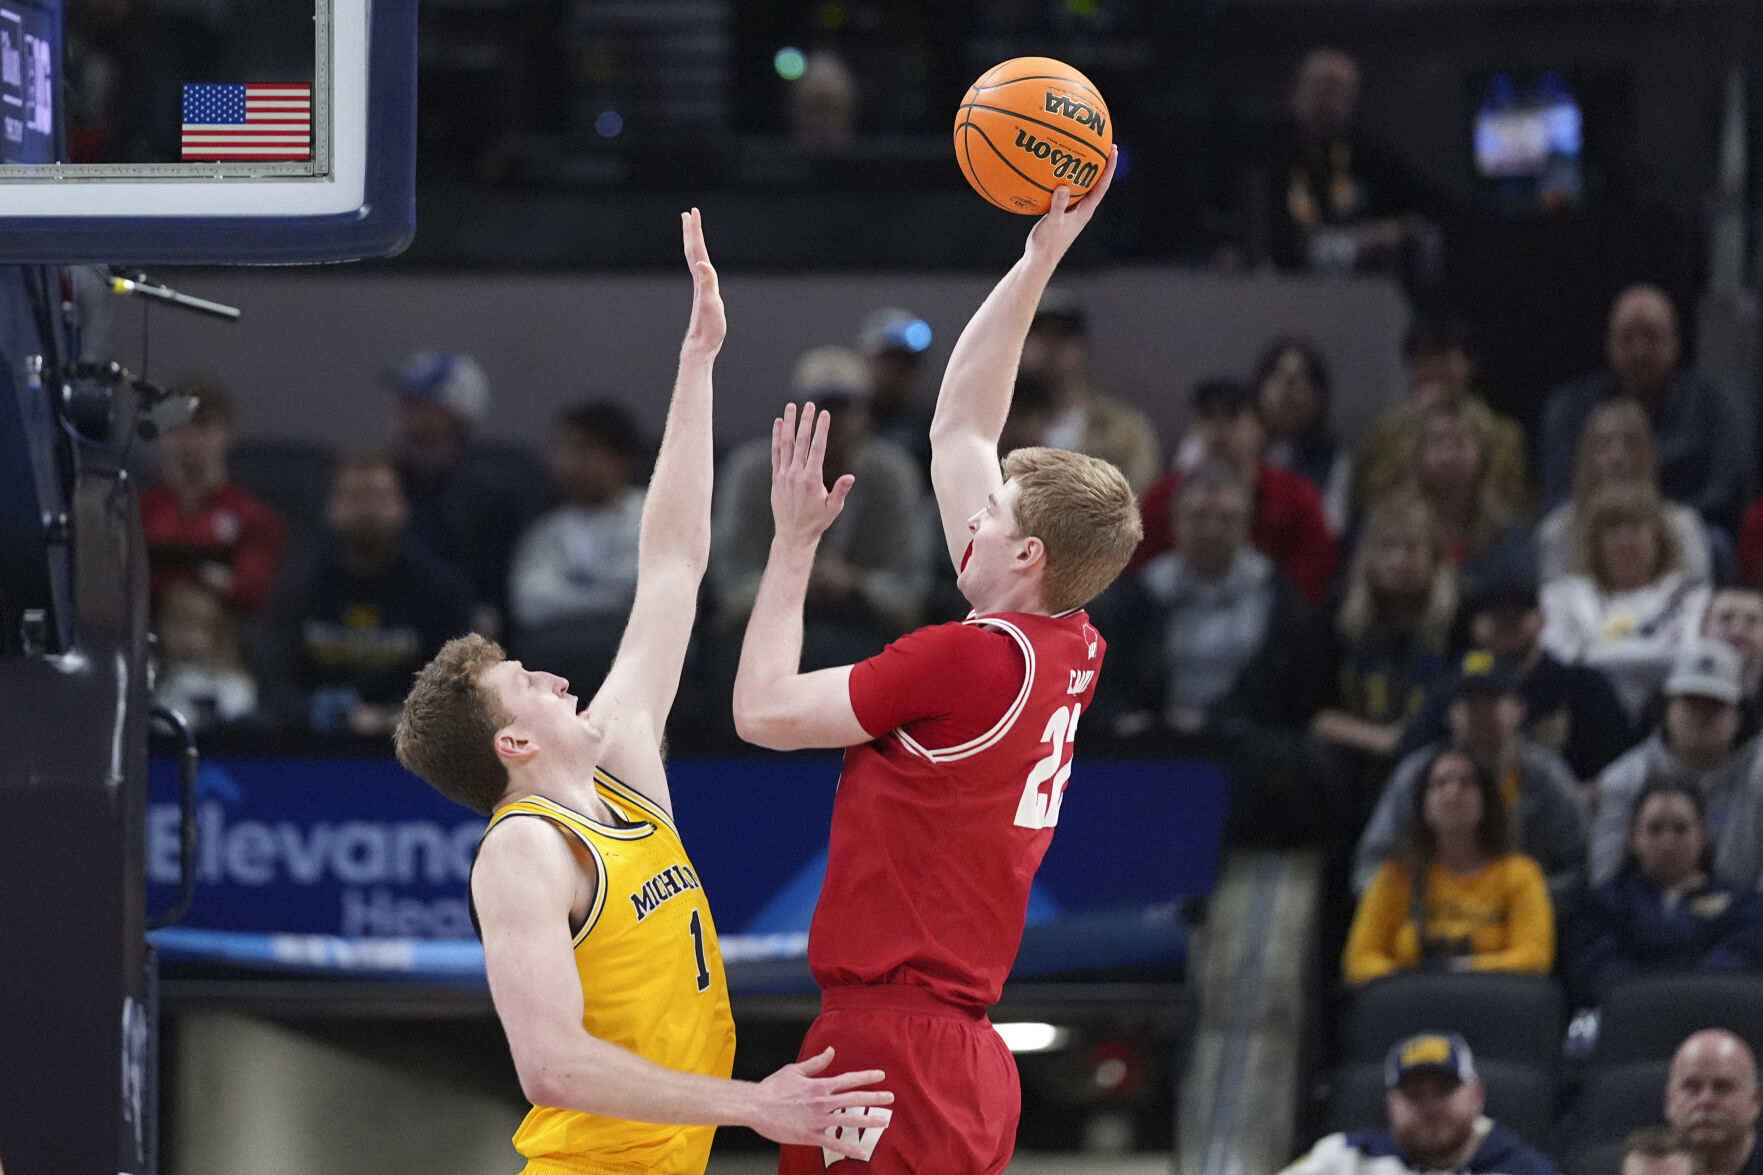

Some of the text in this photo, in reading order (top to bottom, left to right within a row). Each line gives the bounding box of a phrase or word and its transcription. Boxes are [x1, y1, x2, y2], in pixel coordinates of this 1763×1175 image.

[1045, 91, 1106, 137] NCAA
[1014, 128, 1099, 188] Wilson
[147, 801, 486, 885] Elevanc
[689, 908, 710, 993] 1
